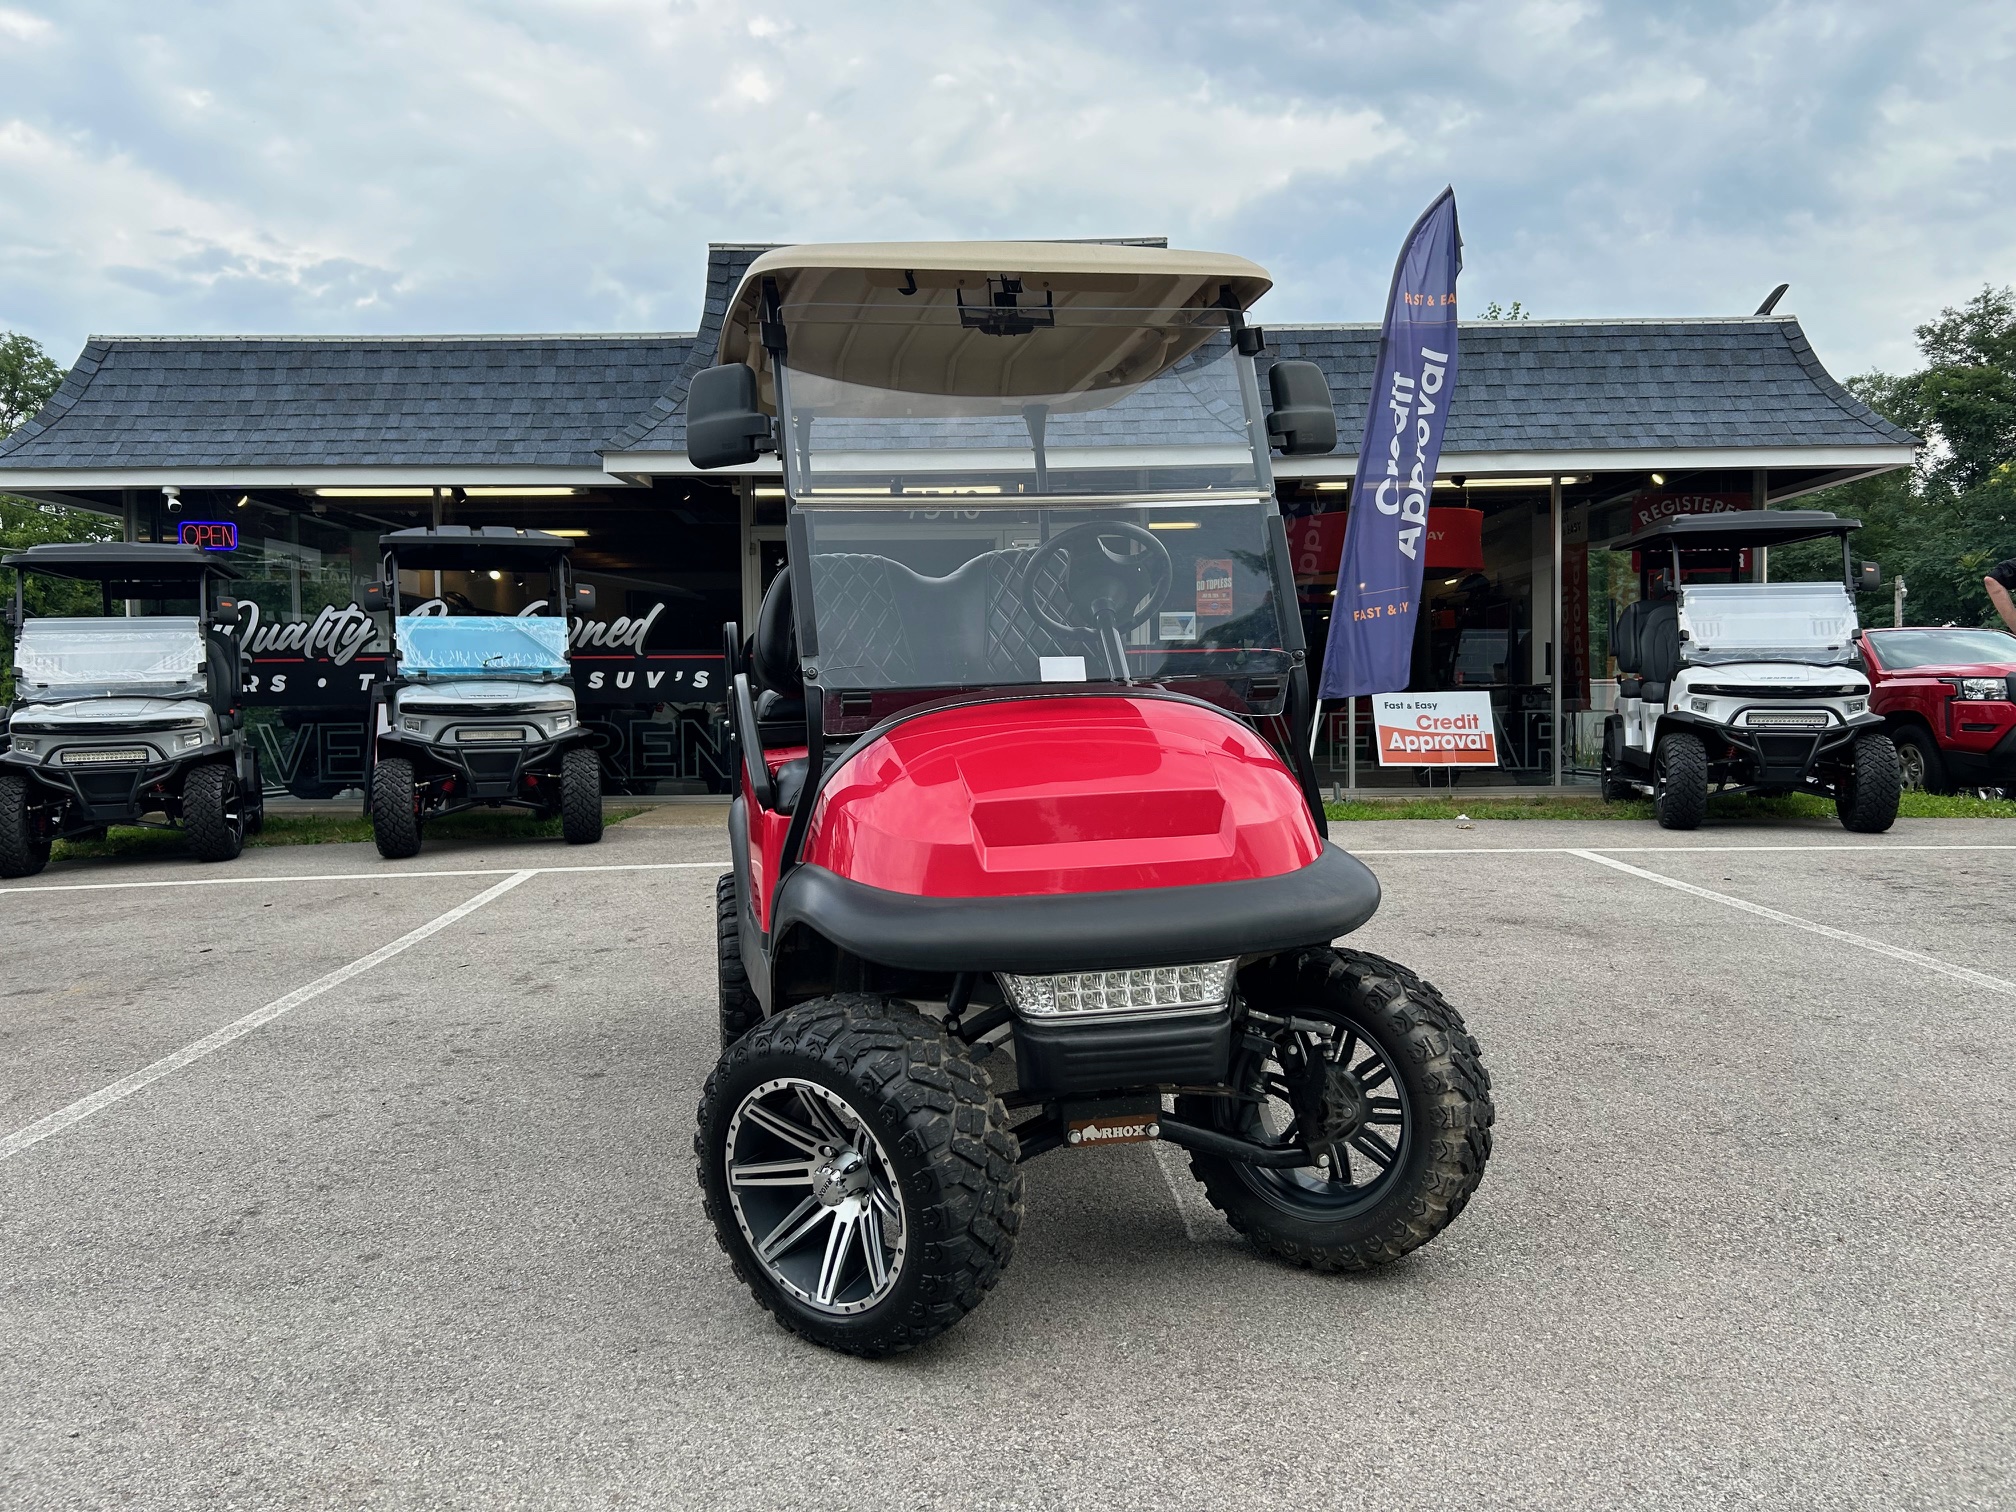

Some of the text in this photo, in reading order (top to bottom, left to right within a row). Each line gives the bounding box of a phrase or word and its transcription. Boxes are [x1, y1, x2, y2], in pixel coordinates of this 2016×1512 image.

[1427, 294, 1435, 306] &
[1440, 292, 1456, 306] EA
[1375, 371, 1415, 515] Credit
[1398, 346, 1449, 560] Approval
[1637, 496, 1743, 525] REGISTERE
[183, 525, 235, 547] OPEN
[1206, 577, 1232, 590] TOPLESS
[1353, 606, 1382, 621] FAST
[1387, 604, 1397, 616] &
[213, 600, 377, 666] Quality
[588, 671, 710, 690] SUV'S
[1384, 702, 1404, 710] Fast
[1415, 702, 1438, 711] Easy
[1416, 714, 1479, 730] Credit
[1389, 731, 1488, 753] Approval
[1101, 1125, 1146, 1138] RHOX
